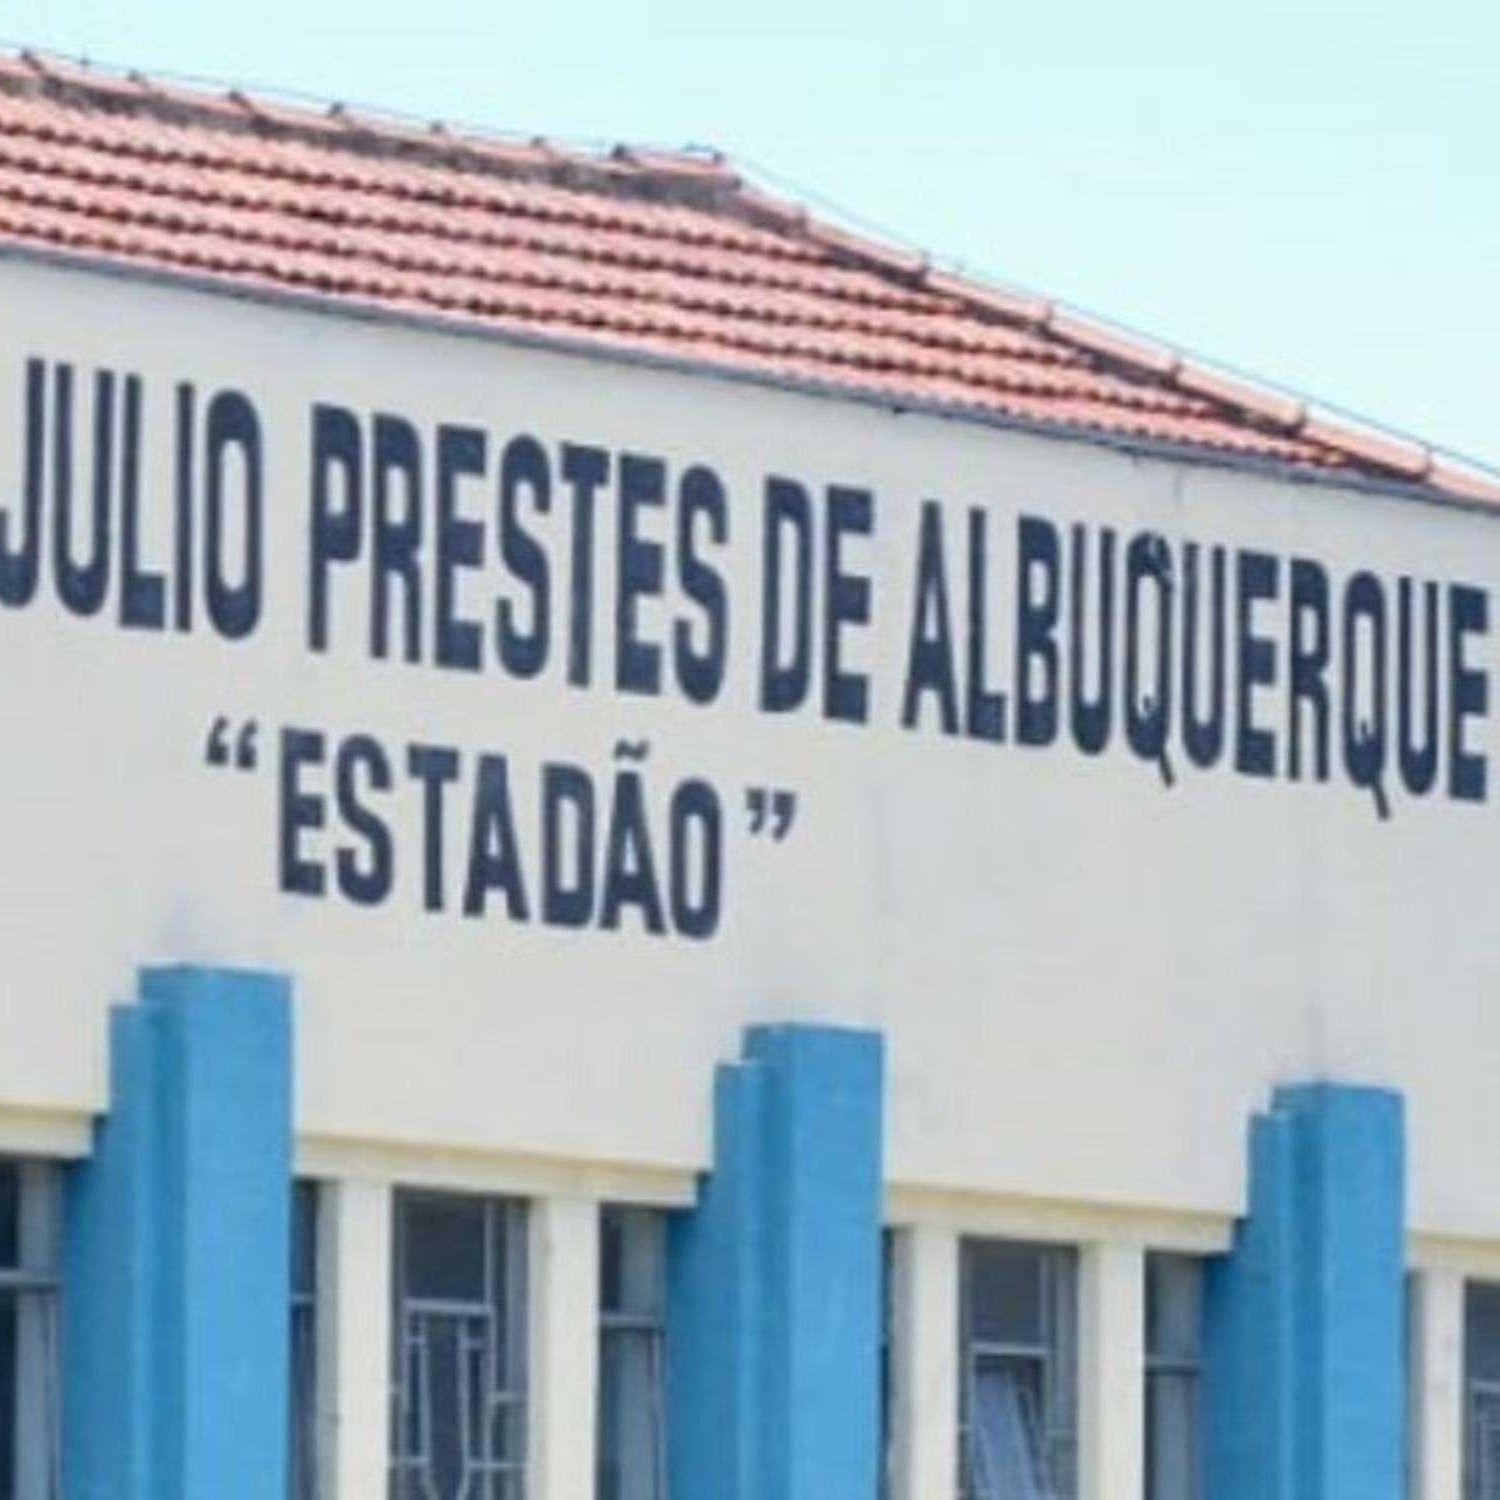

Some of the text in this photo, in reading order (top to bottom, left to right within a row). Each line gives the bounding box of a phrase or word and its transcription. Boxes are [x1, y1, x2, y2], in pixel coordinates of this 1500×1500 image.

[308, 403, 728, 706] PRESTES
[759, 475, 874, 725] DE
[900, 500, 1491, 822] ALBUQUERQUE
